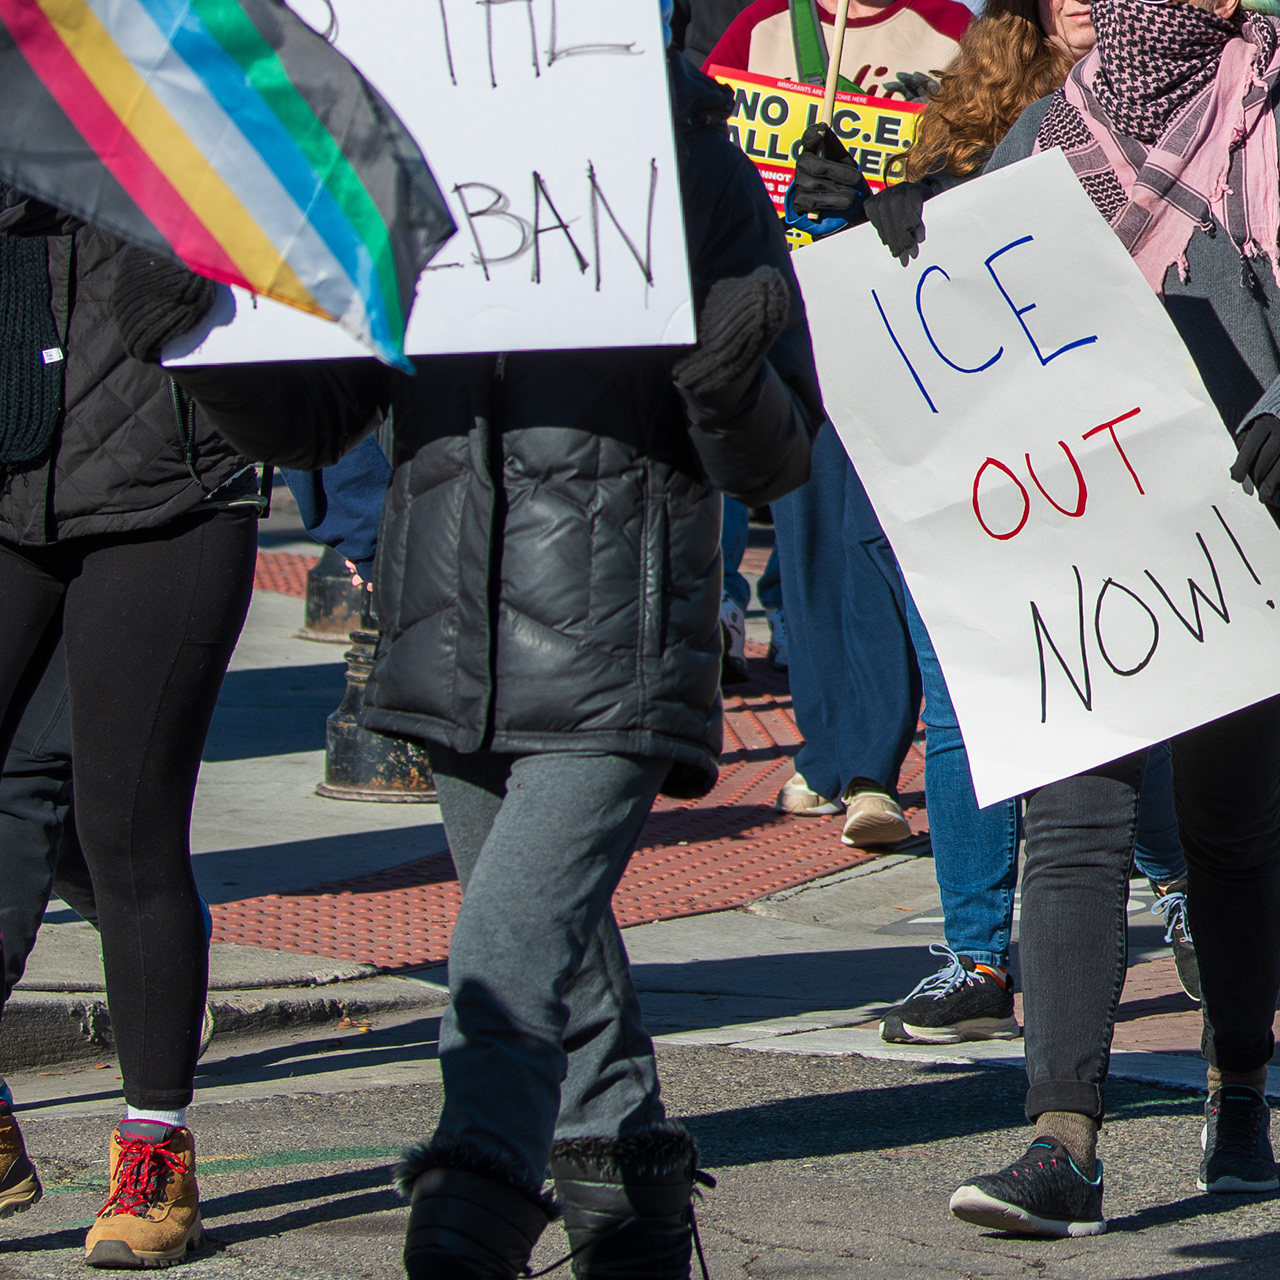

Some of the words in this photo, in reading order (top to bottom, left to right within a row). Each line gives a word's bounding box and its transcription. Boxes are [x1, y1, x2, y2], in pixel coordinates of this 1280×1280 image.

[733, 87, 790, 126] NO
[806, 101, 912, 150] IC.E.
[776, 80, 812, 95] IMMIGRANTS
[811, 86, 823, 97] ARE
[849, 95, 868, 105] HERE
[871, 234, 1098, 413] ICE
[971, 406, 1146, 541] OUT
[1029, 503, 1276, 724] NOW!
